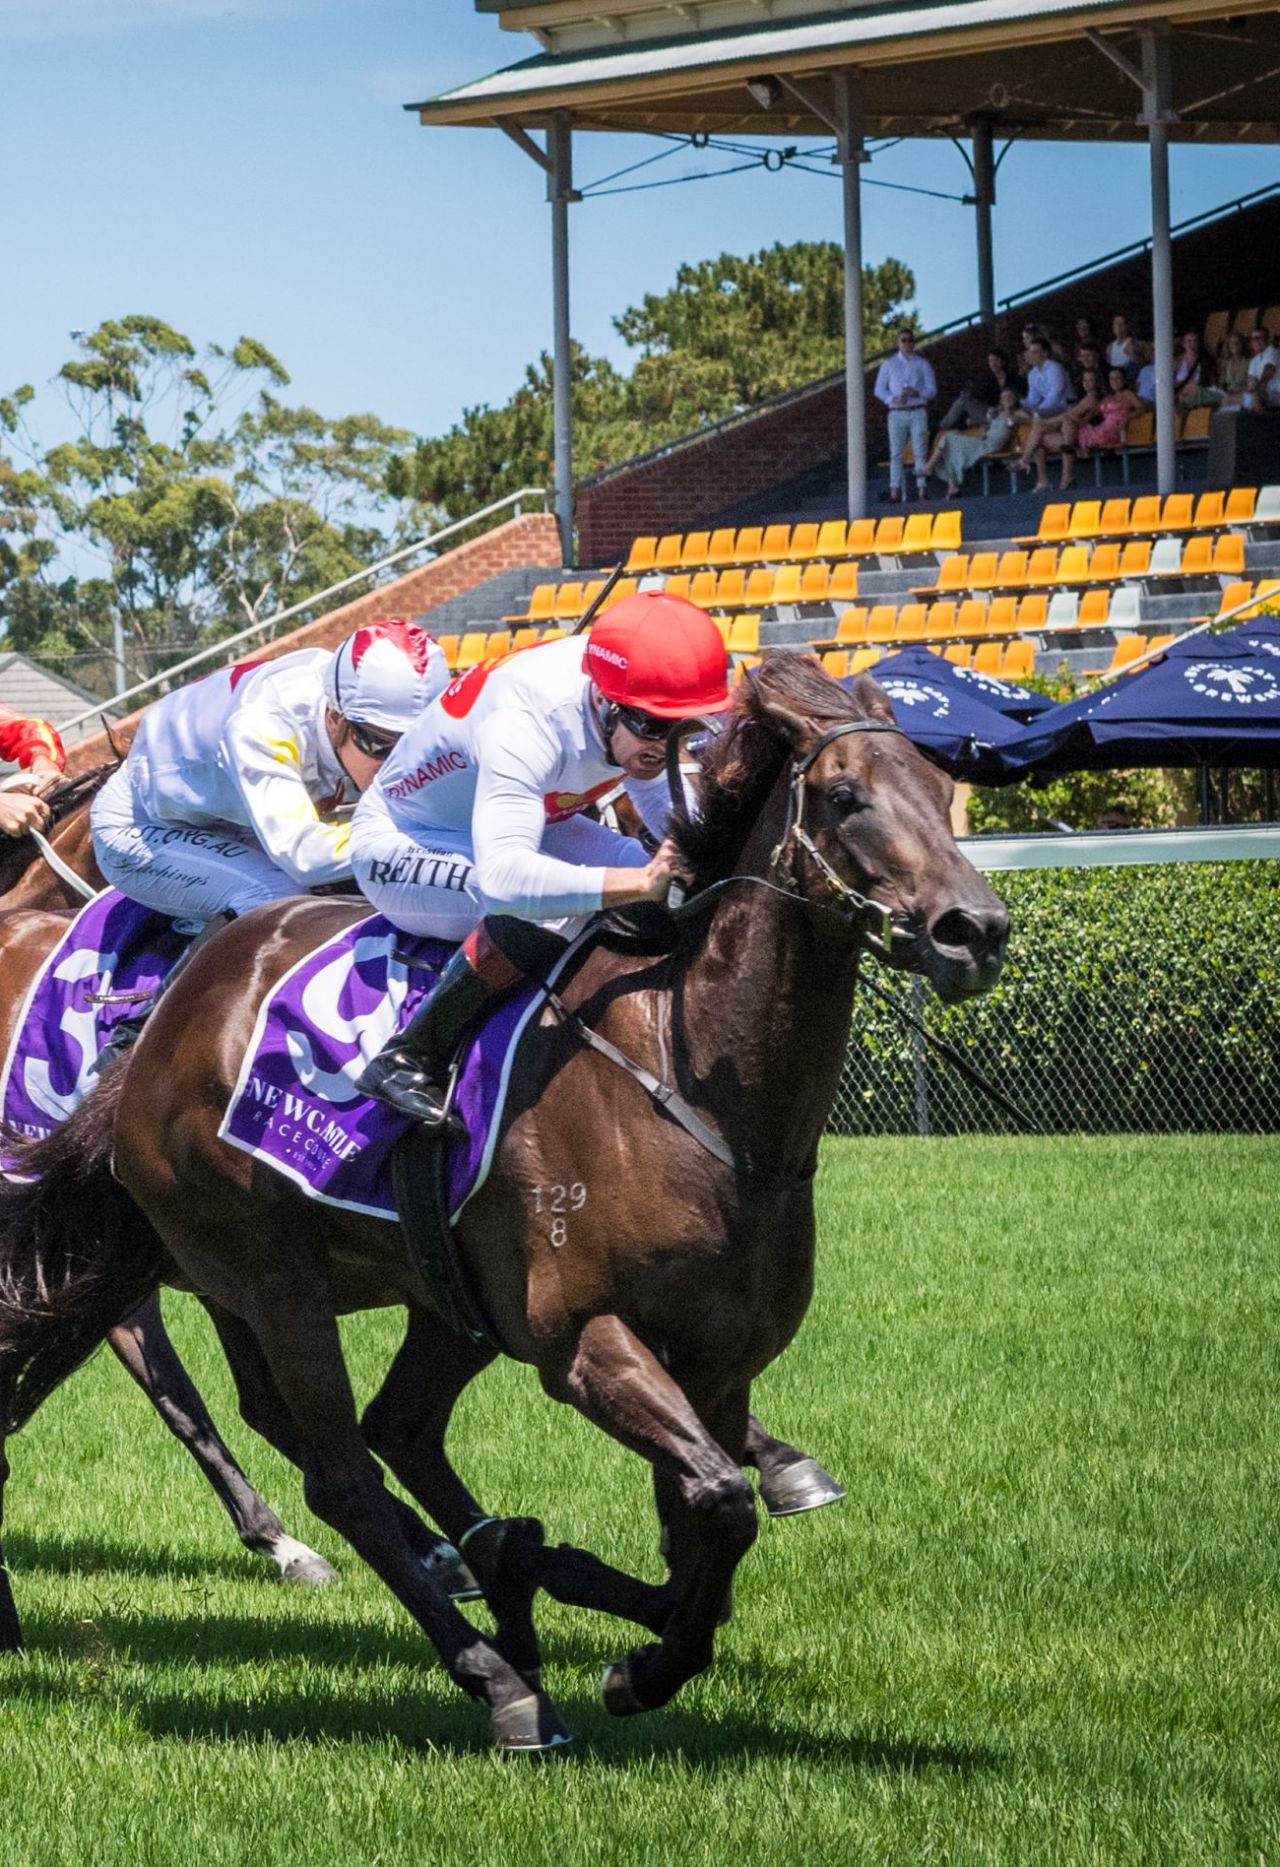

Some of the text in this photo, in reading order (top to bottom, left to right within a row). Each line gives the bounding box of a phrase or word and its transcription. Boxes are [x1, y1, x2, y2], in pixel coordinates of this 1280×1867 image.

[387, 751, 468, 799] DYNAMIC
[368, 857, 475, 893] REITH
[550, 1217, 568, 1247] 8
